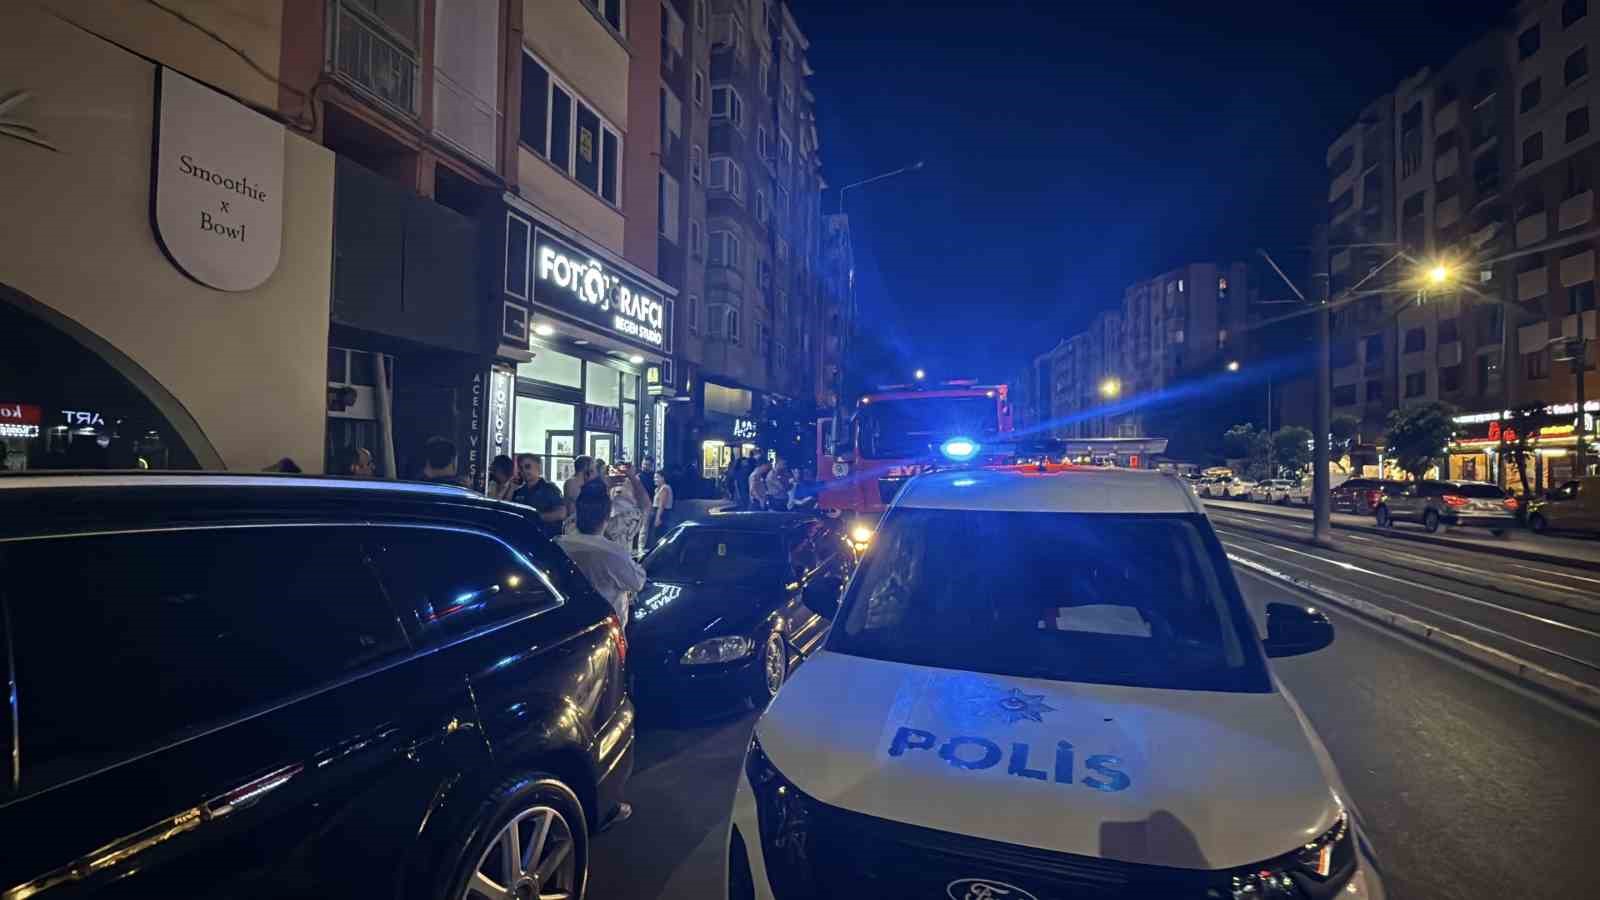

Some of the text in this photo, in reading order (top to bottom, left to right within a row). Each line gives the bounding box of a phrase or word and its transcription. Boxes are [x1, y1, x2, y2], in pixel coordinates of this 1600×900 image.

[179, 155, 267, 202] Smoothie
[200, 211, 246, 242] Bowl
[220, 201, 231, 213] x
[887, 725, 1132, 793] POLİS
